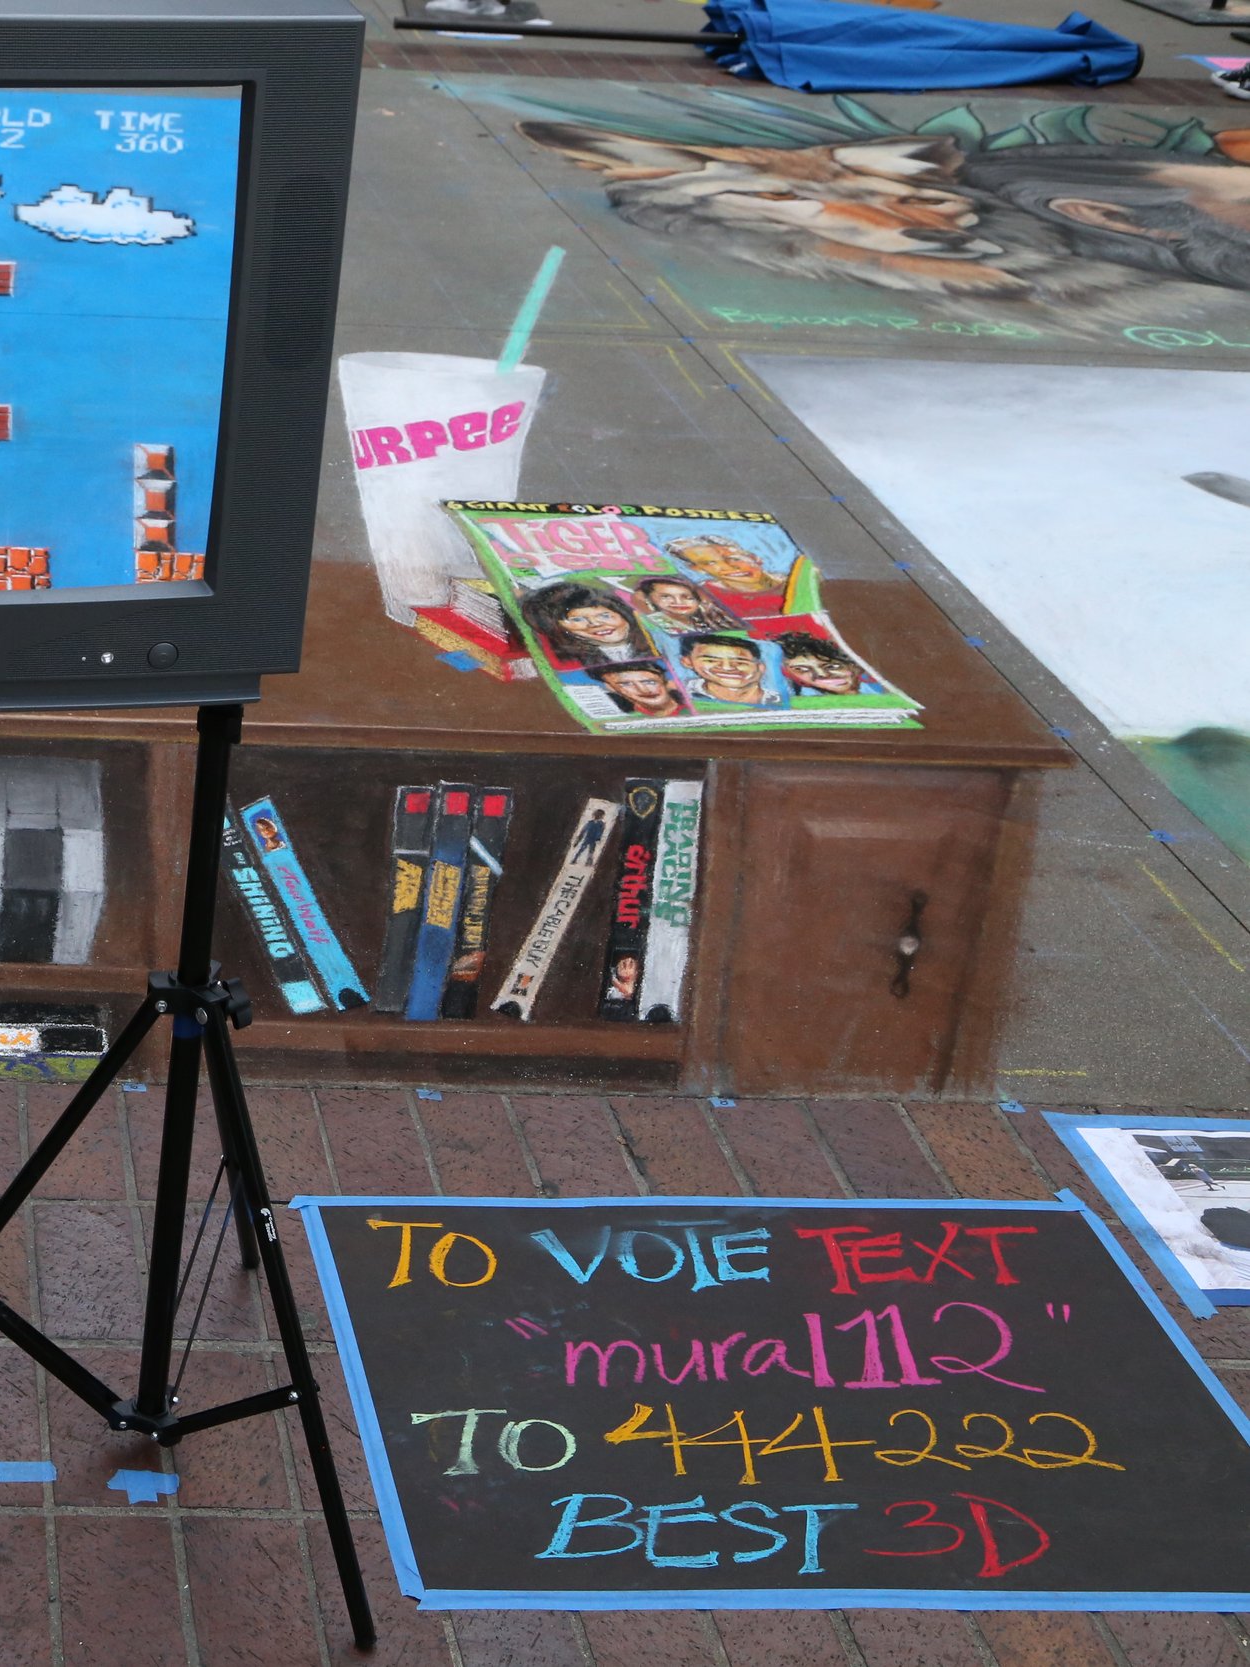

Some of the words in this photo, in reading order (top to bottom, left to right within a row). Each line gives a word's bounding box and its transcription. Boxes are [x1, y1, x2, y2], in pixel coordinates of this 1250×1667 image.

[94, 109, 185, 133] TIME
[114, 131, 185, 155] 360
[466, 501, 549, 513] GIANT
[366, 1218, 498, 1290] TO
[529, 1219, 773, 1293] VOTE
[795, 1221, 1040, 1296] TEXT
[411, 1407, 578, 1477] TO
[534, 1493, 860, 1576] BEST
[862, 1491, 1051, 1579] 3D
